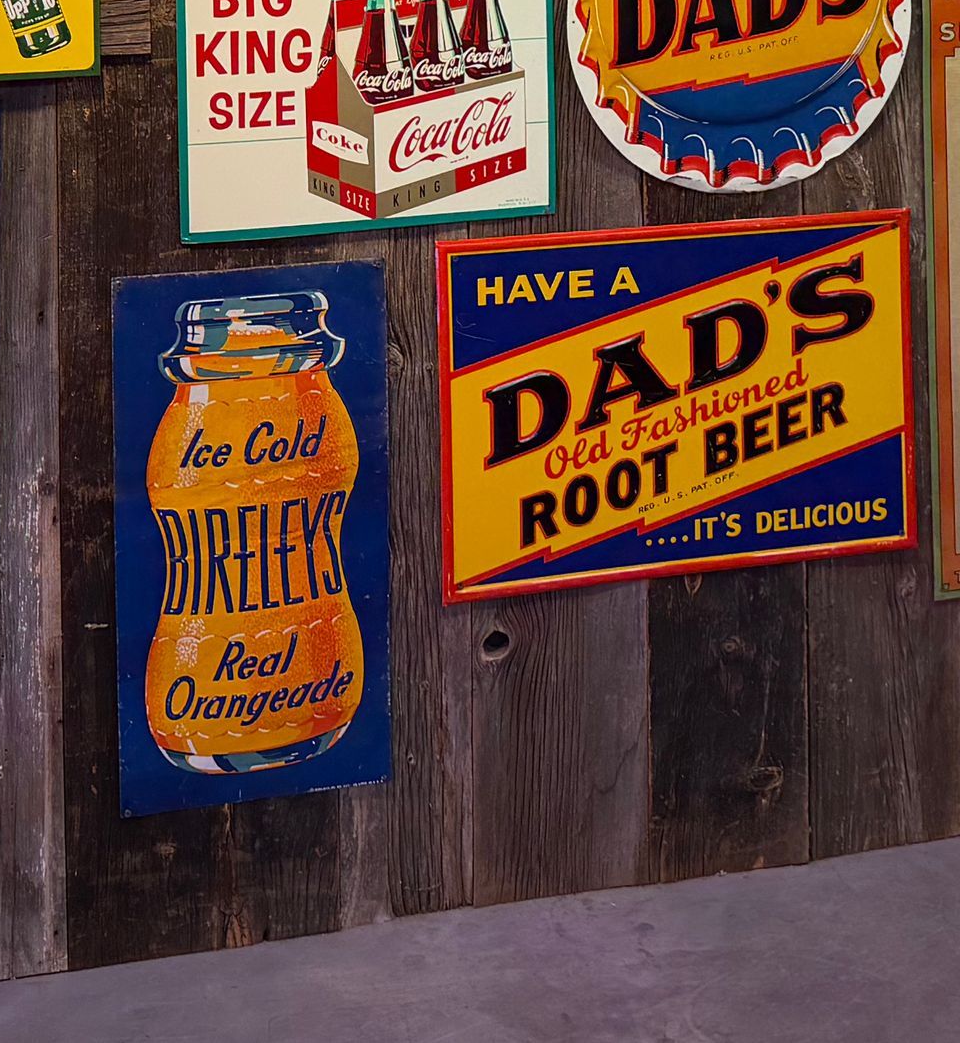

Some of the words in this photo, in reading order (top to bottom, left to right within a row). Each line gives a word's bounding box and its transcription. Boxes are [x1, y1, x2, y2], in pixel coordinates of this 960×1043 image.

[195, 28, 314, 78] KING
[354, 67, 412, 93] Coca-Cola
[208, 90, 296, 131] SIZE
[389, 91, 516, 173] Coca-Cola
[316, 127, 363, 154] Coke
[313, 178, 335, 197] KING
[346, 190, 370, 212] SIZE
[393, 180, 441, 207] KING
[470, 157, 513, 182] SIZE
[476, 268, 596, 307] HAVE
[609, 265, 640, 296] A
[483, 251, 876, 472] DAD'S
[179, 428, 233, 469] Ice
[242, 416, 327, 466] Cold
[543, 431, 613, 480] Old
[620, 358, 810, 451] Fashioned
[520, 438, 680, 551] ROOT
[703, 381, 849, 479] BEER
[755, 497, 889, 535] DELICIOUS
[212, 632, 299, 683] Real
[164, 667, 354, 731] Orangeade
